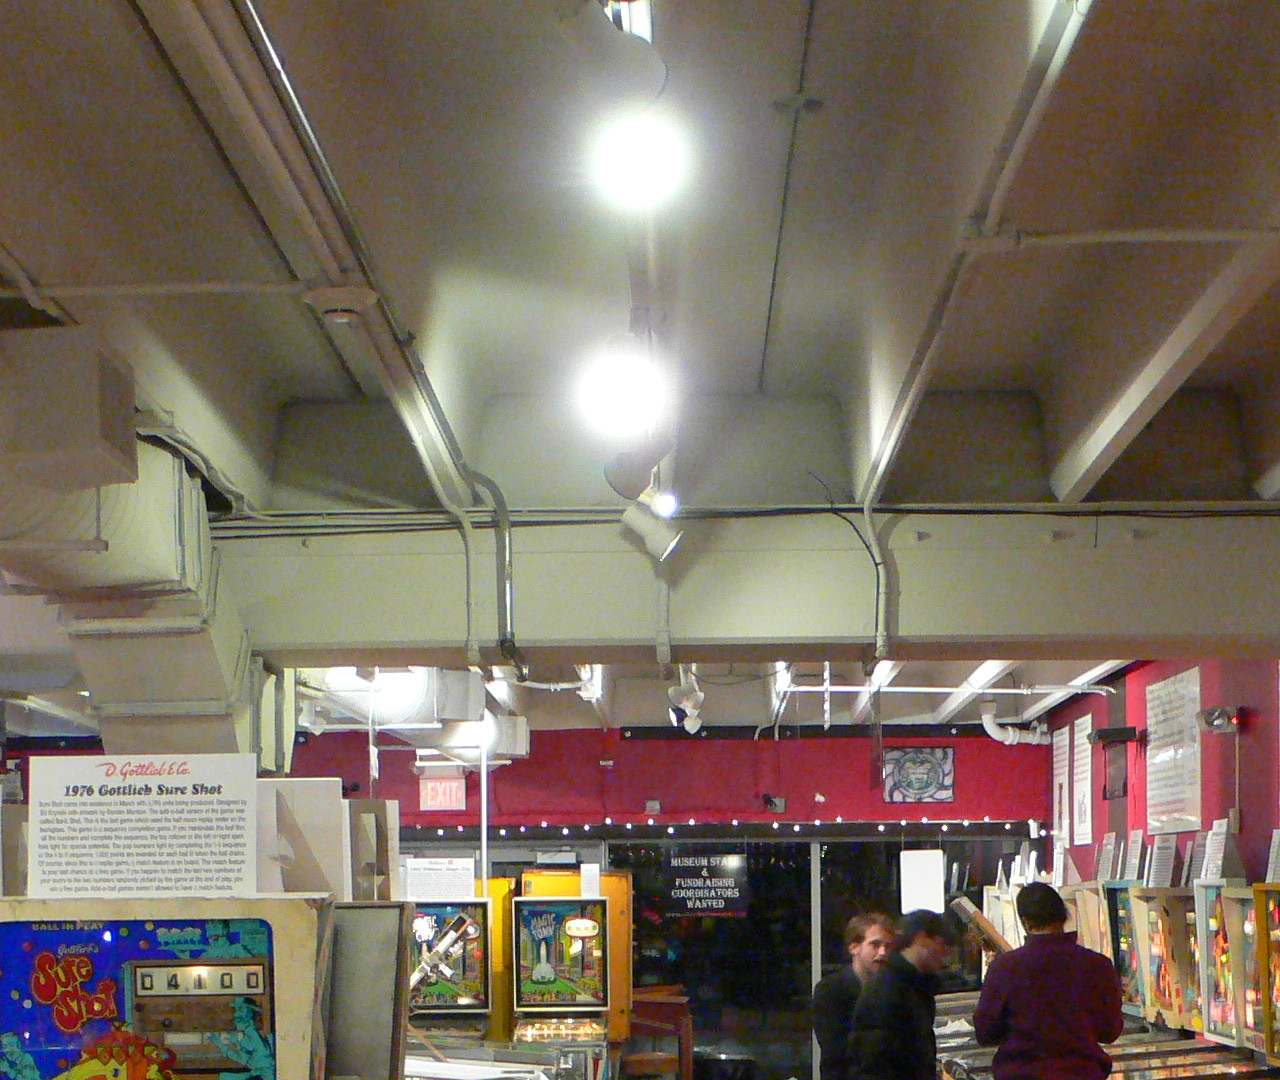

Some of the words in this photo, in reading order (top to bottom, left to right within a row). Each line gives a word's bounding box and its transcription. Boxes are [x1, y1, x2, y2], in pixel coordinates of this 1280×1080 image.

[64, 784, 94, 797] 1976
[98, 783, 152, 797] Gottlieb
[156, 784, 187, 796] Sure
[192, 782, 222, 796] Shot
[428, 782, 459, 807] EXIT
[671, 857, 708, 867] MUSEUM
[701, 868, 709, 876] &
[675, 878, 735, 887] FUNDRAISING
[672, 888, 739, 898] COORDINATORS
[686, 900, 725, 908] WANTED
[62, 922, 75, 930] IN
[76, 922, 105, 930] PLAY
[530, 912, 556, 929] MAGIC
[532, 925, 554, 940] TOWN
[31, 952, 94, 1004] Sure
[53, 977, 118, 1032] Shot
